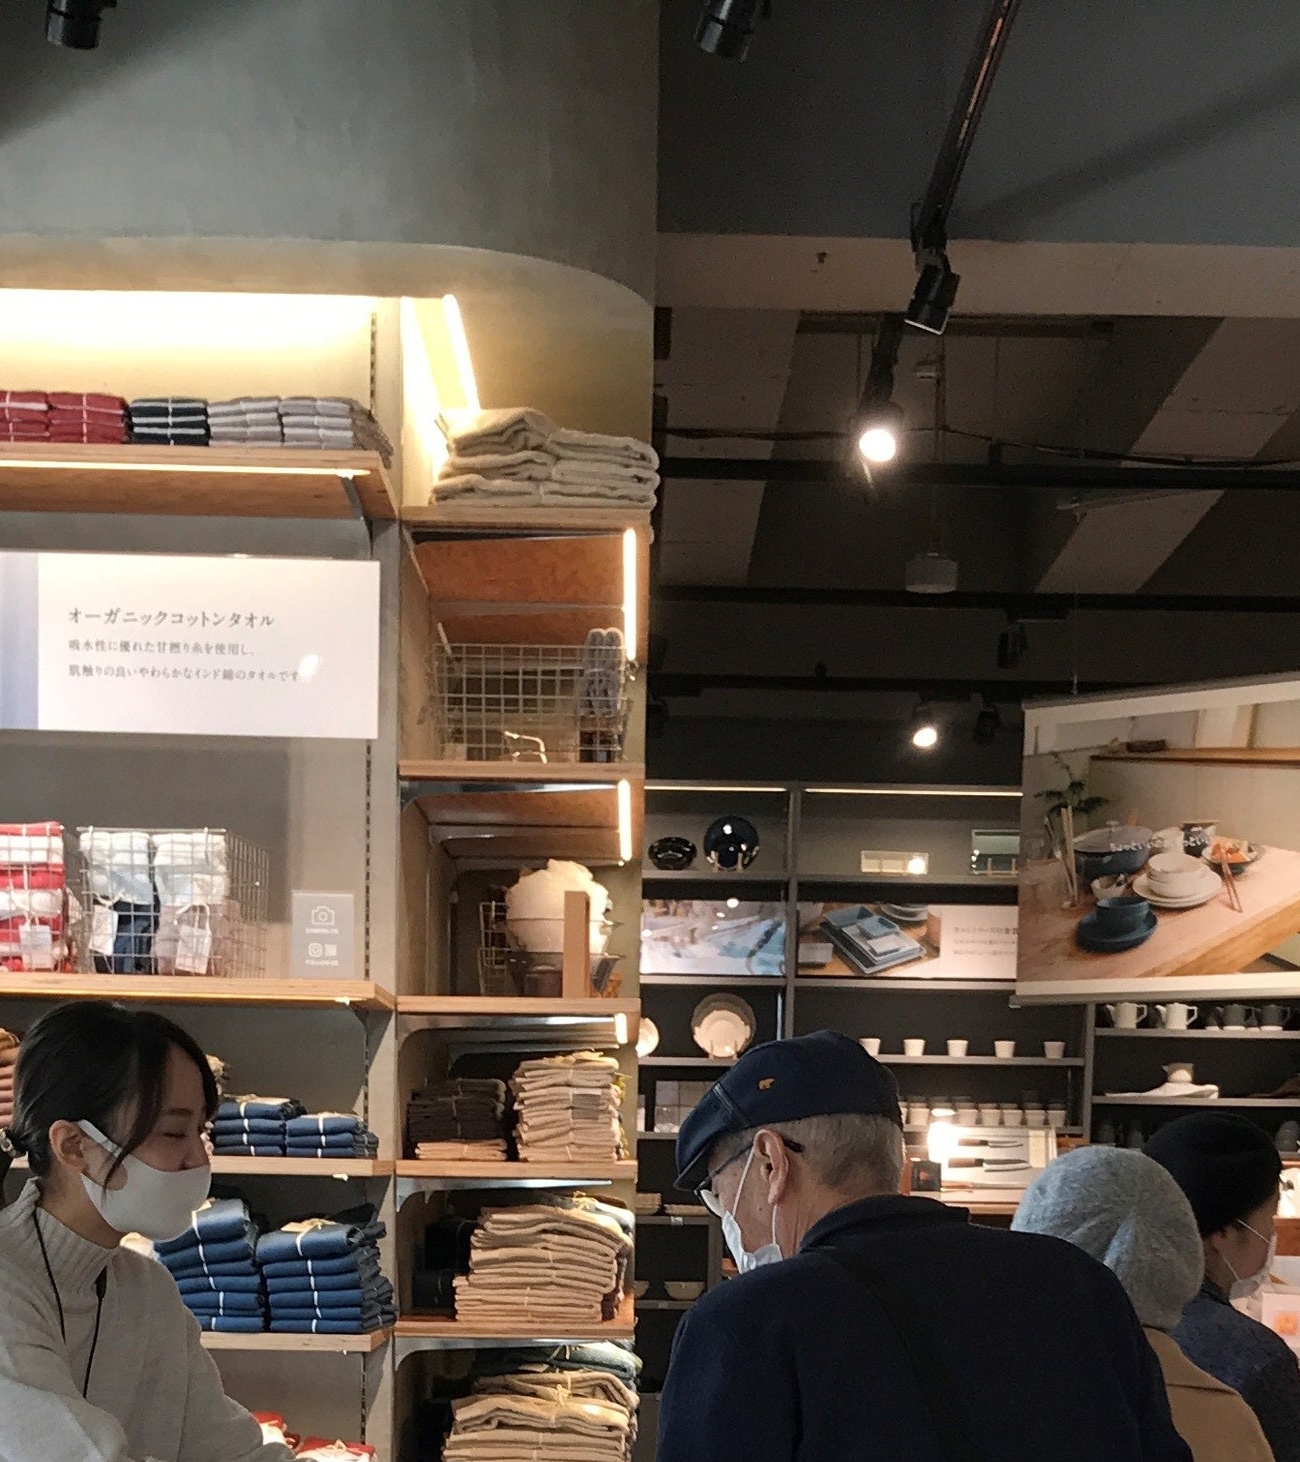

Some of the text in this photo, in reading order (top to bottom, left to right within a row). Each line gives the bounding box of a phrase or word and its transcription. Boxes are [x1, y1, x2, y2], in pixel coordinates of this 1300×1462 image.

[69, 608, 275, 628] オーガニックコットンタオル
